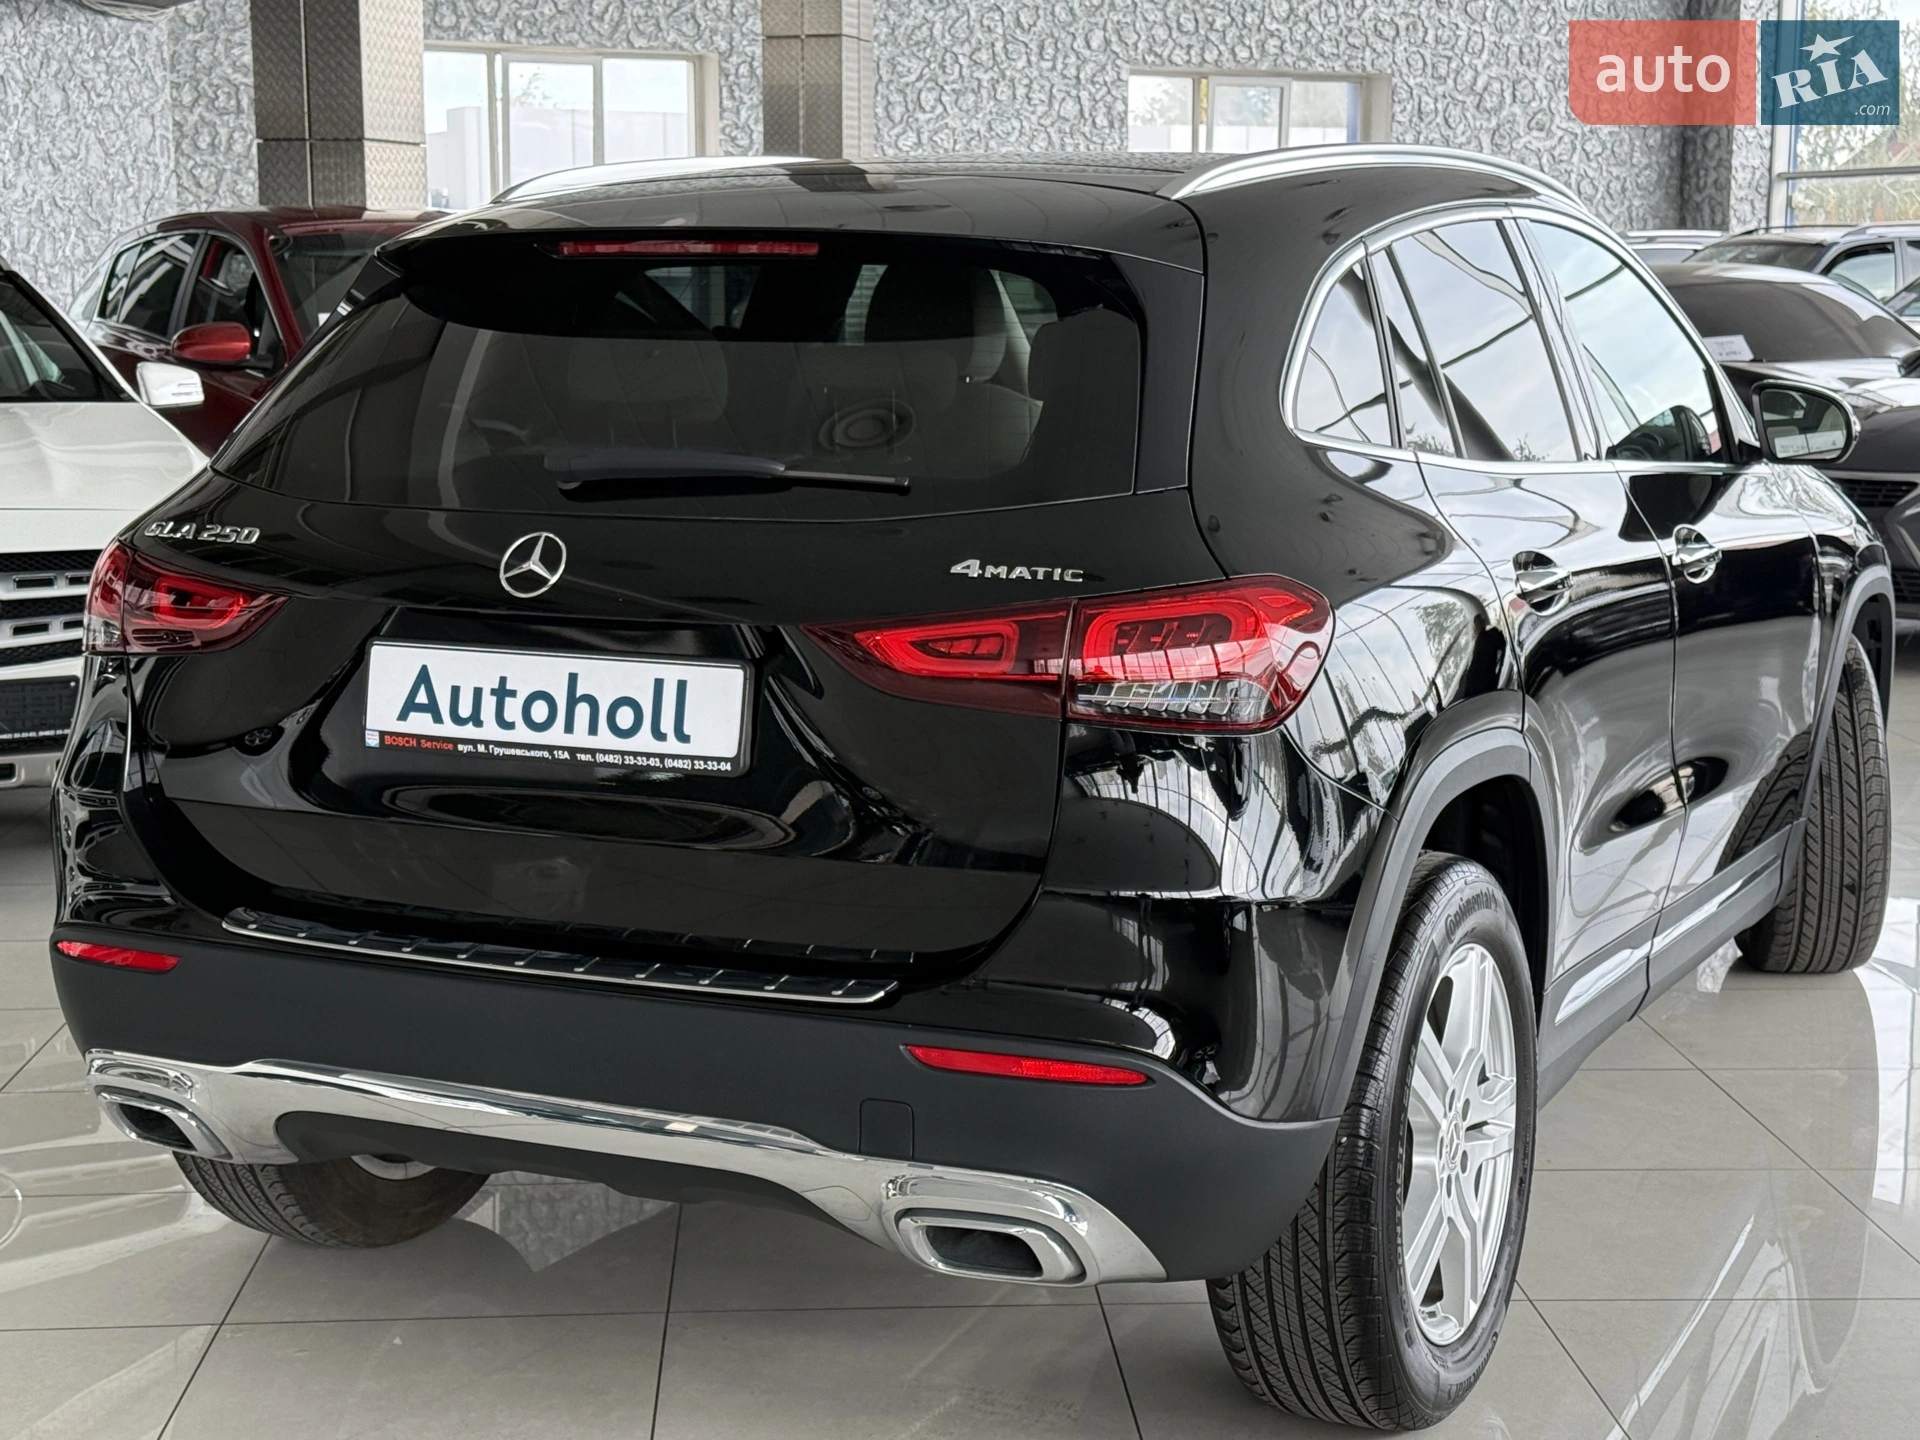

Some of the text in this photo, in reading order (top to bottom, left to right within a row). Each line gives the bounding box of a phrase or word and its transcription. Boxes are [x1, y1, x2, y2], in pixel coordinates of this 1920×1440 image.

[144, 521, 260, 544] GLA 250
[950, 559, 1084, 582] 4MATIC
[396, 664, 691, 744] Autoholl
[383, 735, 417, 748] BOSCH
[420, 739, 454, 750] Service
[457, 743, 476, 754] вул.
[477, 744, 488, 753] М.
[575, 753, 594, 762] тел.
[595, 752, 622, 764] (0482)
[623, 755, 663, 768] 33-33-03,
[664, 758, 692, 770] (0482)
[693, 760, 732, 771] 33-33-04
[1445, 886, 1492, 944] Continental
